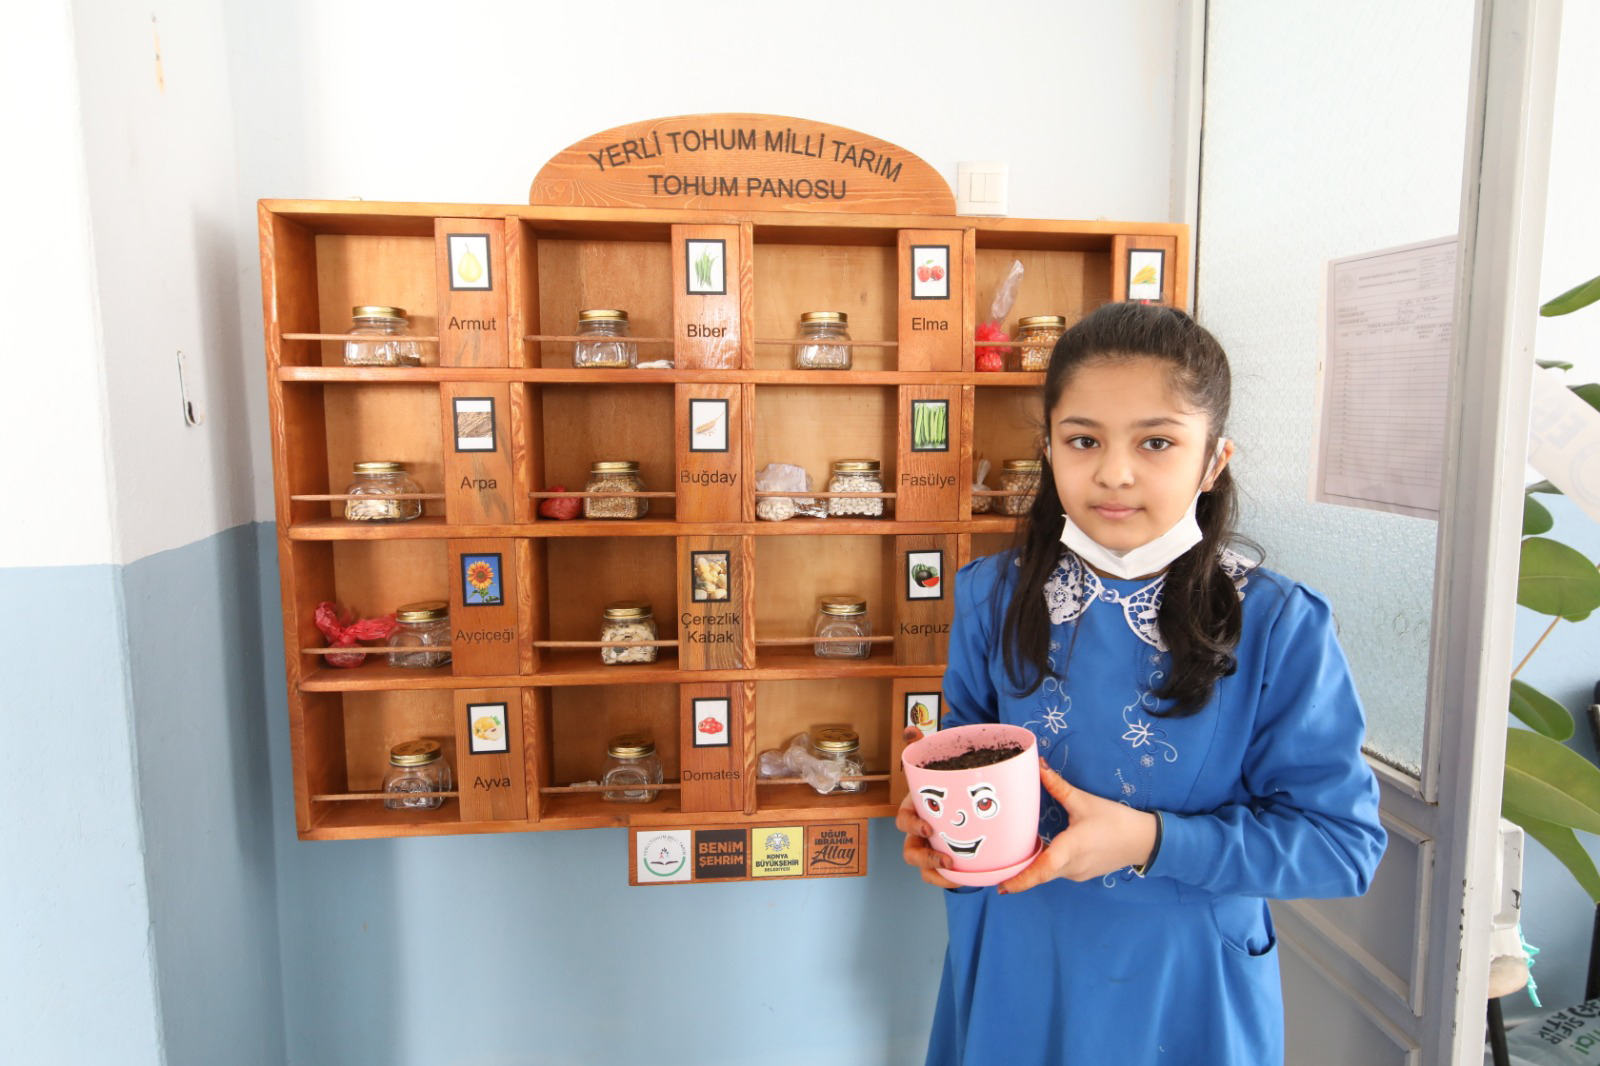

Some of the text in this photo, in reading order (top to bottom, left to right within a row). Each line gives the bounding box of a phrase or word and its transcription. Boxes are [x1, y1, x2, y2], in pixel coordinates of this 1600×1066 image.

[588, 128, 903, 183] YERLİ TOHUM MİLLİ TARIM
[648, 174, 846, 200] TOHUM PANOSU
[448, 316, 497, 331] Armut
[687, 323, 727, 338] Biber
[911, 317, 949, 331] Elma
[460, 476, 497, 492] Arpa
[680, 470, 737, 487] Buğday
[901, 473, 956, 489] Fasülye
[681, 612, 740, 629] Çerezlik
[455, 629, 514, 645] Ayçiçeği
[687, 630, 735, 644] Kabak
[900, 622, 950, 637] Karpuz
[683, 769, 741, 782] Domates
[473, 776, 511, 792] Ayva
[698, 841, 744, 854] BENİM
[810, 845, 856, 866] Altay
[699, 854, 744, 868] ŞEHRİM
